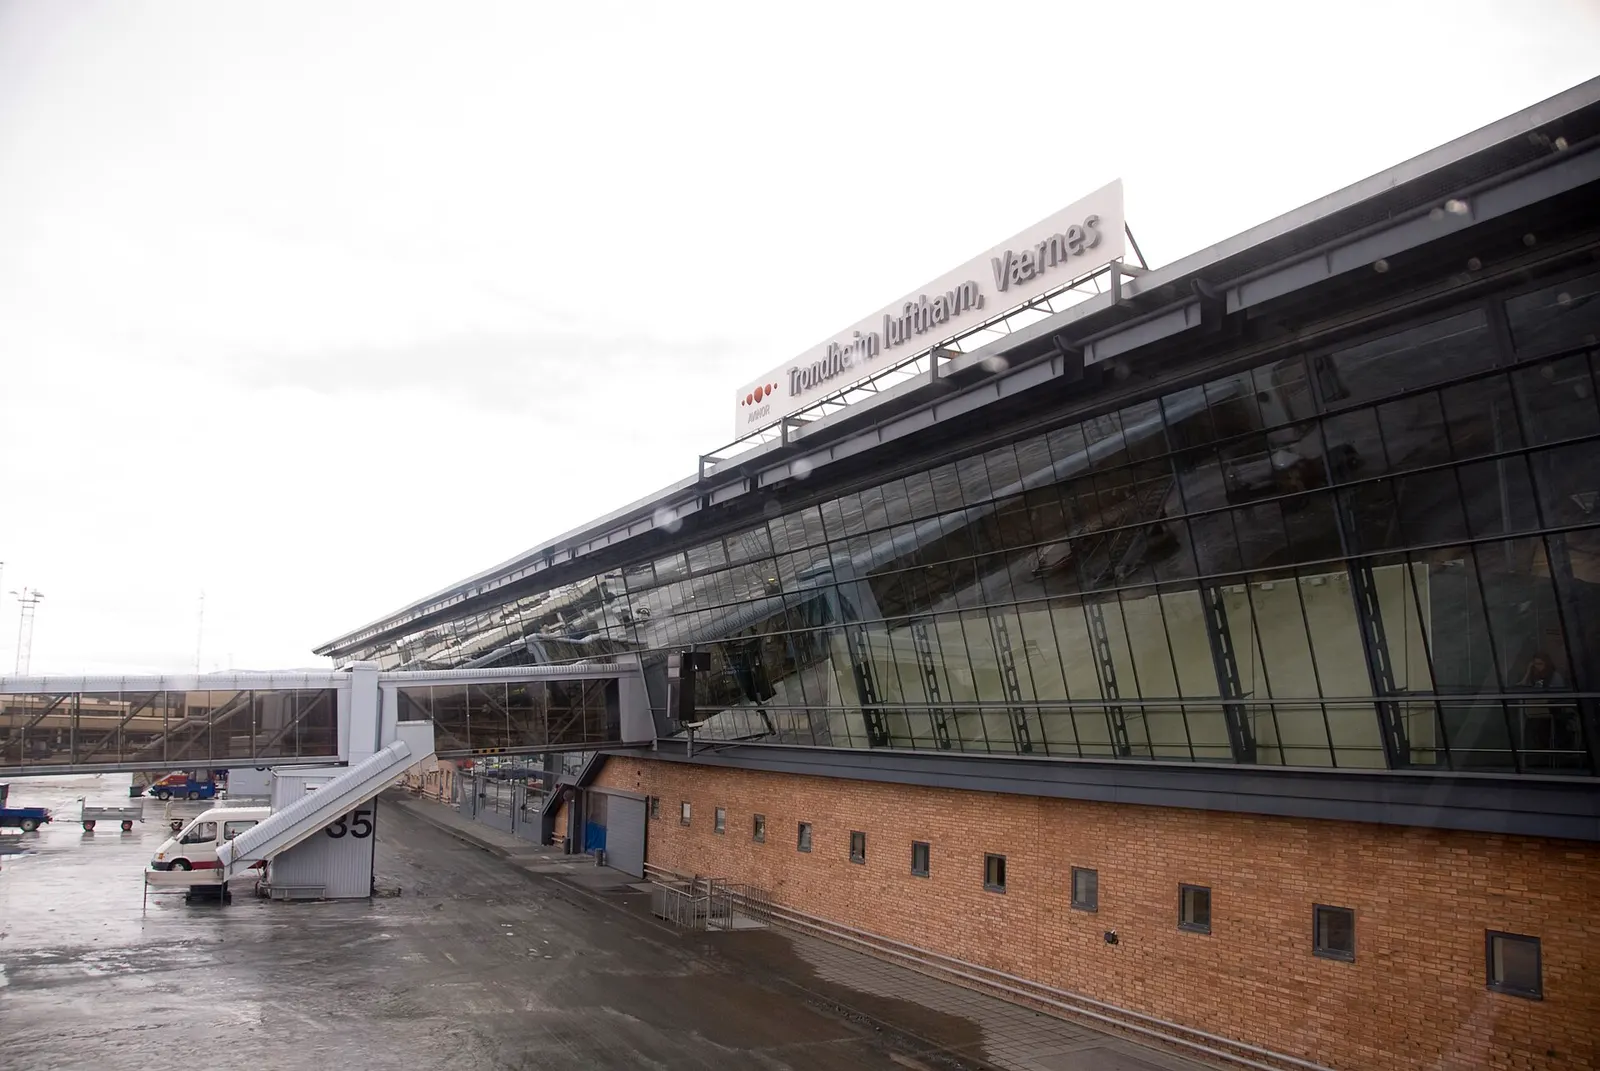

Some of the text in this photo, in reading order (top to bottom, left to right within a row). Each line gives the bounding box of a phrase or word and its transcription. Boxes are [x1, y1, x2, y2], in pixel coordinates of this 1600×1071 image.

[787, 214, 1101, 397] Trondheim lufthavn, Værnes
[747, 404, 771, 424] AVINOR
[325, 810, 372, 838] 35
